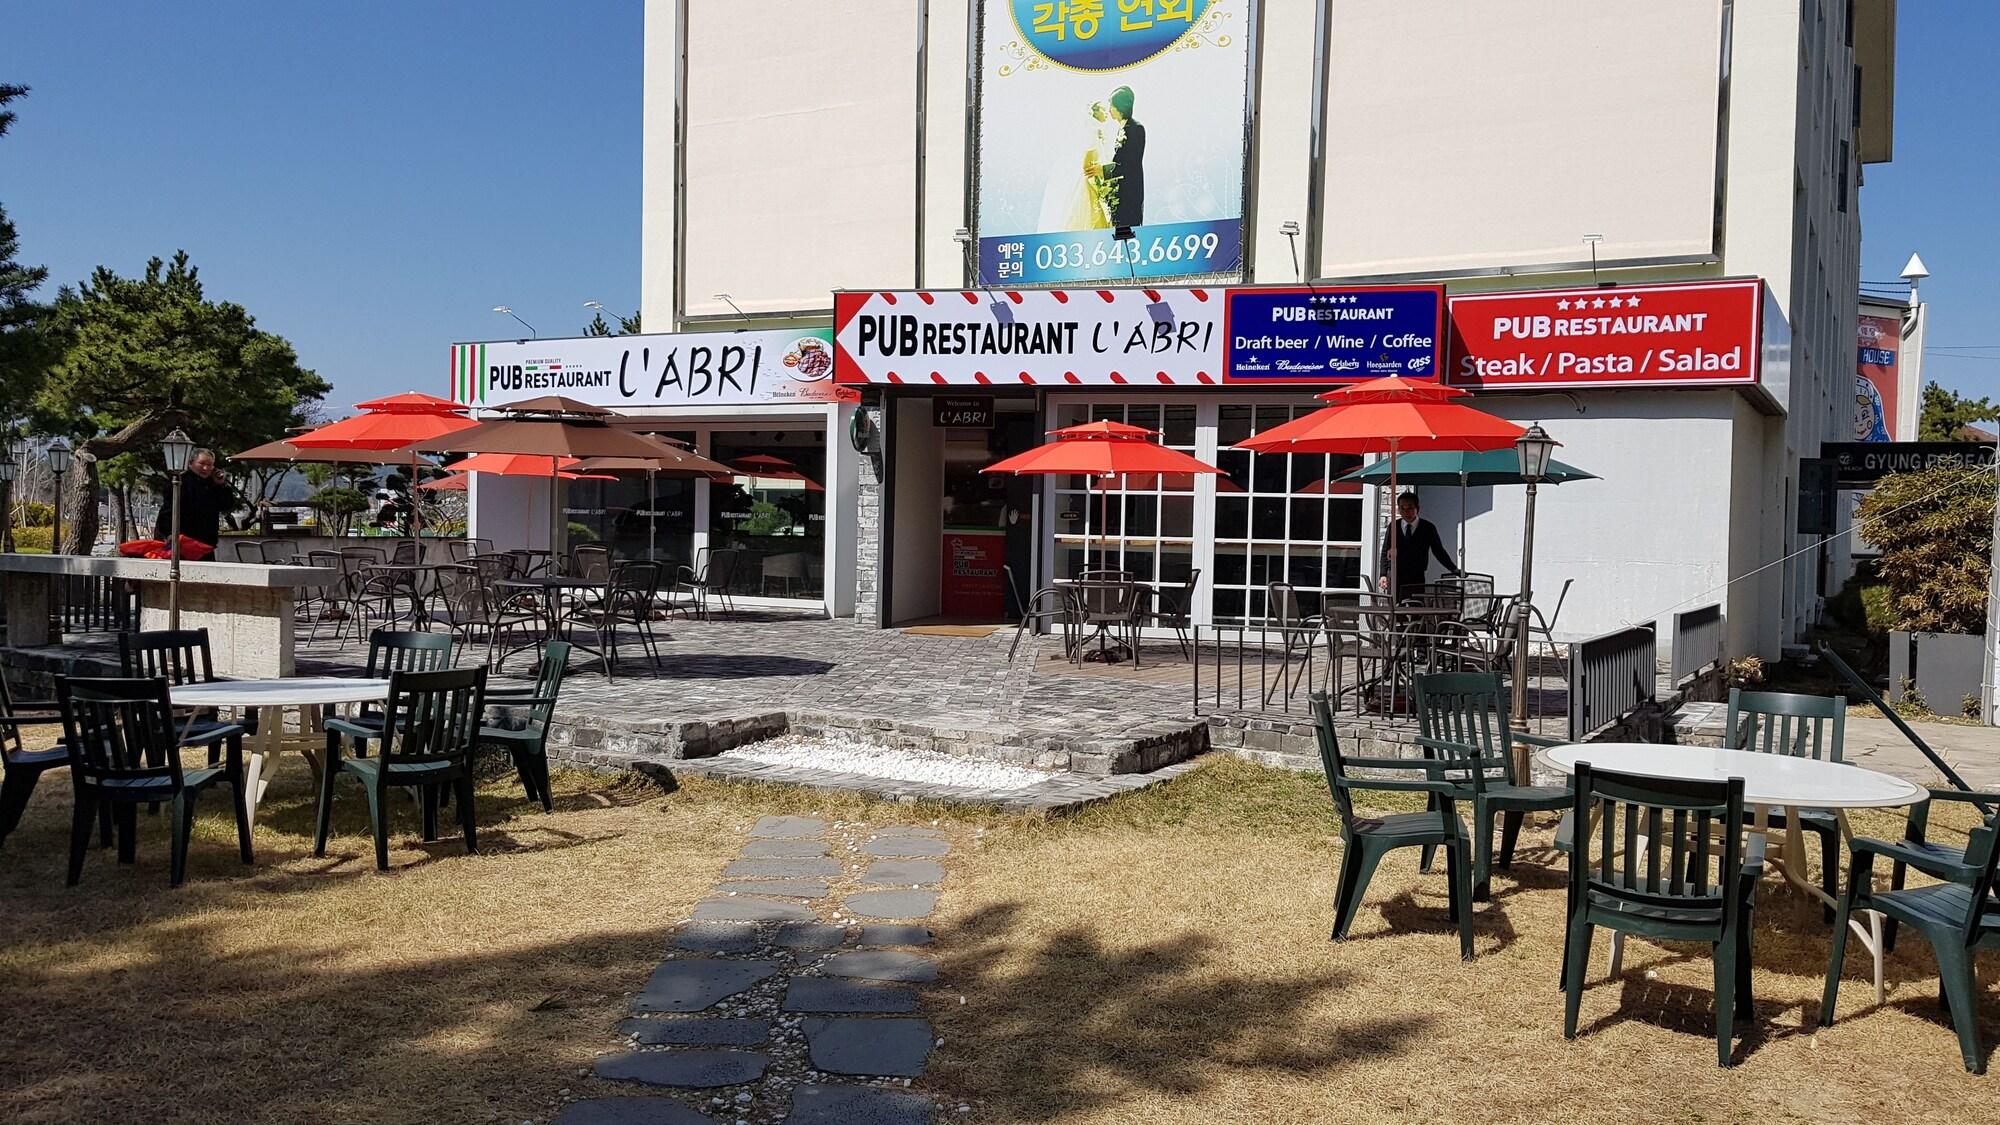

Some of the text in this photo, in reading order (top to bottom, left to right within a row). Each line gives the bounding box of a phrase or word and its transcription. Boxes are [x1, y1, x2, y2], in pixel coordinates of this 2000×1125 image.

[1033, 0, 1104, 40] 각종
[997, 242, 1025, 259] 예약
[1035, 232, 1219, 269] 033.643.6699
[997, 261, 1024, 279] 문의
[1272, 306, 1394, 322] PUB RESTAURANT
[858, 314, 1213, 357] PUB RESTAURANT L'ABRI
[1493, 313, 1707, 340] PUB RESTAURANT
[1235, 335, 1272, 350] Draft
[1275, 335, 1309, 349] beer
[1326, 334, 1364, 349] Wine
[1382, 333, 1432, 348] Coffee
[1460, 352, 1535, 377] Steak
[1557, 351, 1633, 374] Pasta
[1658, 345, 1741, 372] Salad
[1862, 348, 1891, 365] HOUSE
[619, 345, 762, 398] L'ABRI
[1235, 363, 1270, 371] Heineken
[489, 365, 611, 390] PUB RESTAURANT
[940, 411, 986, 424] L'ABRI
[1864, 453, 1921, 470] GYUNG
